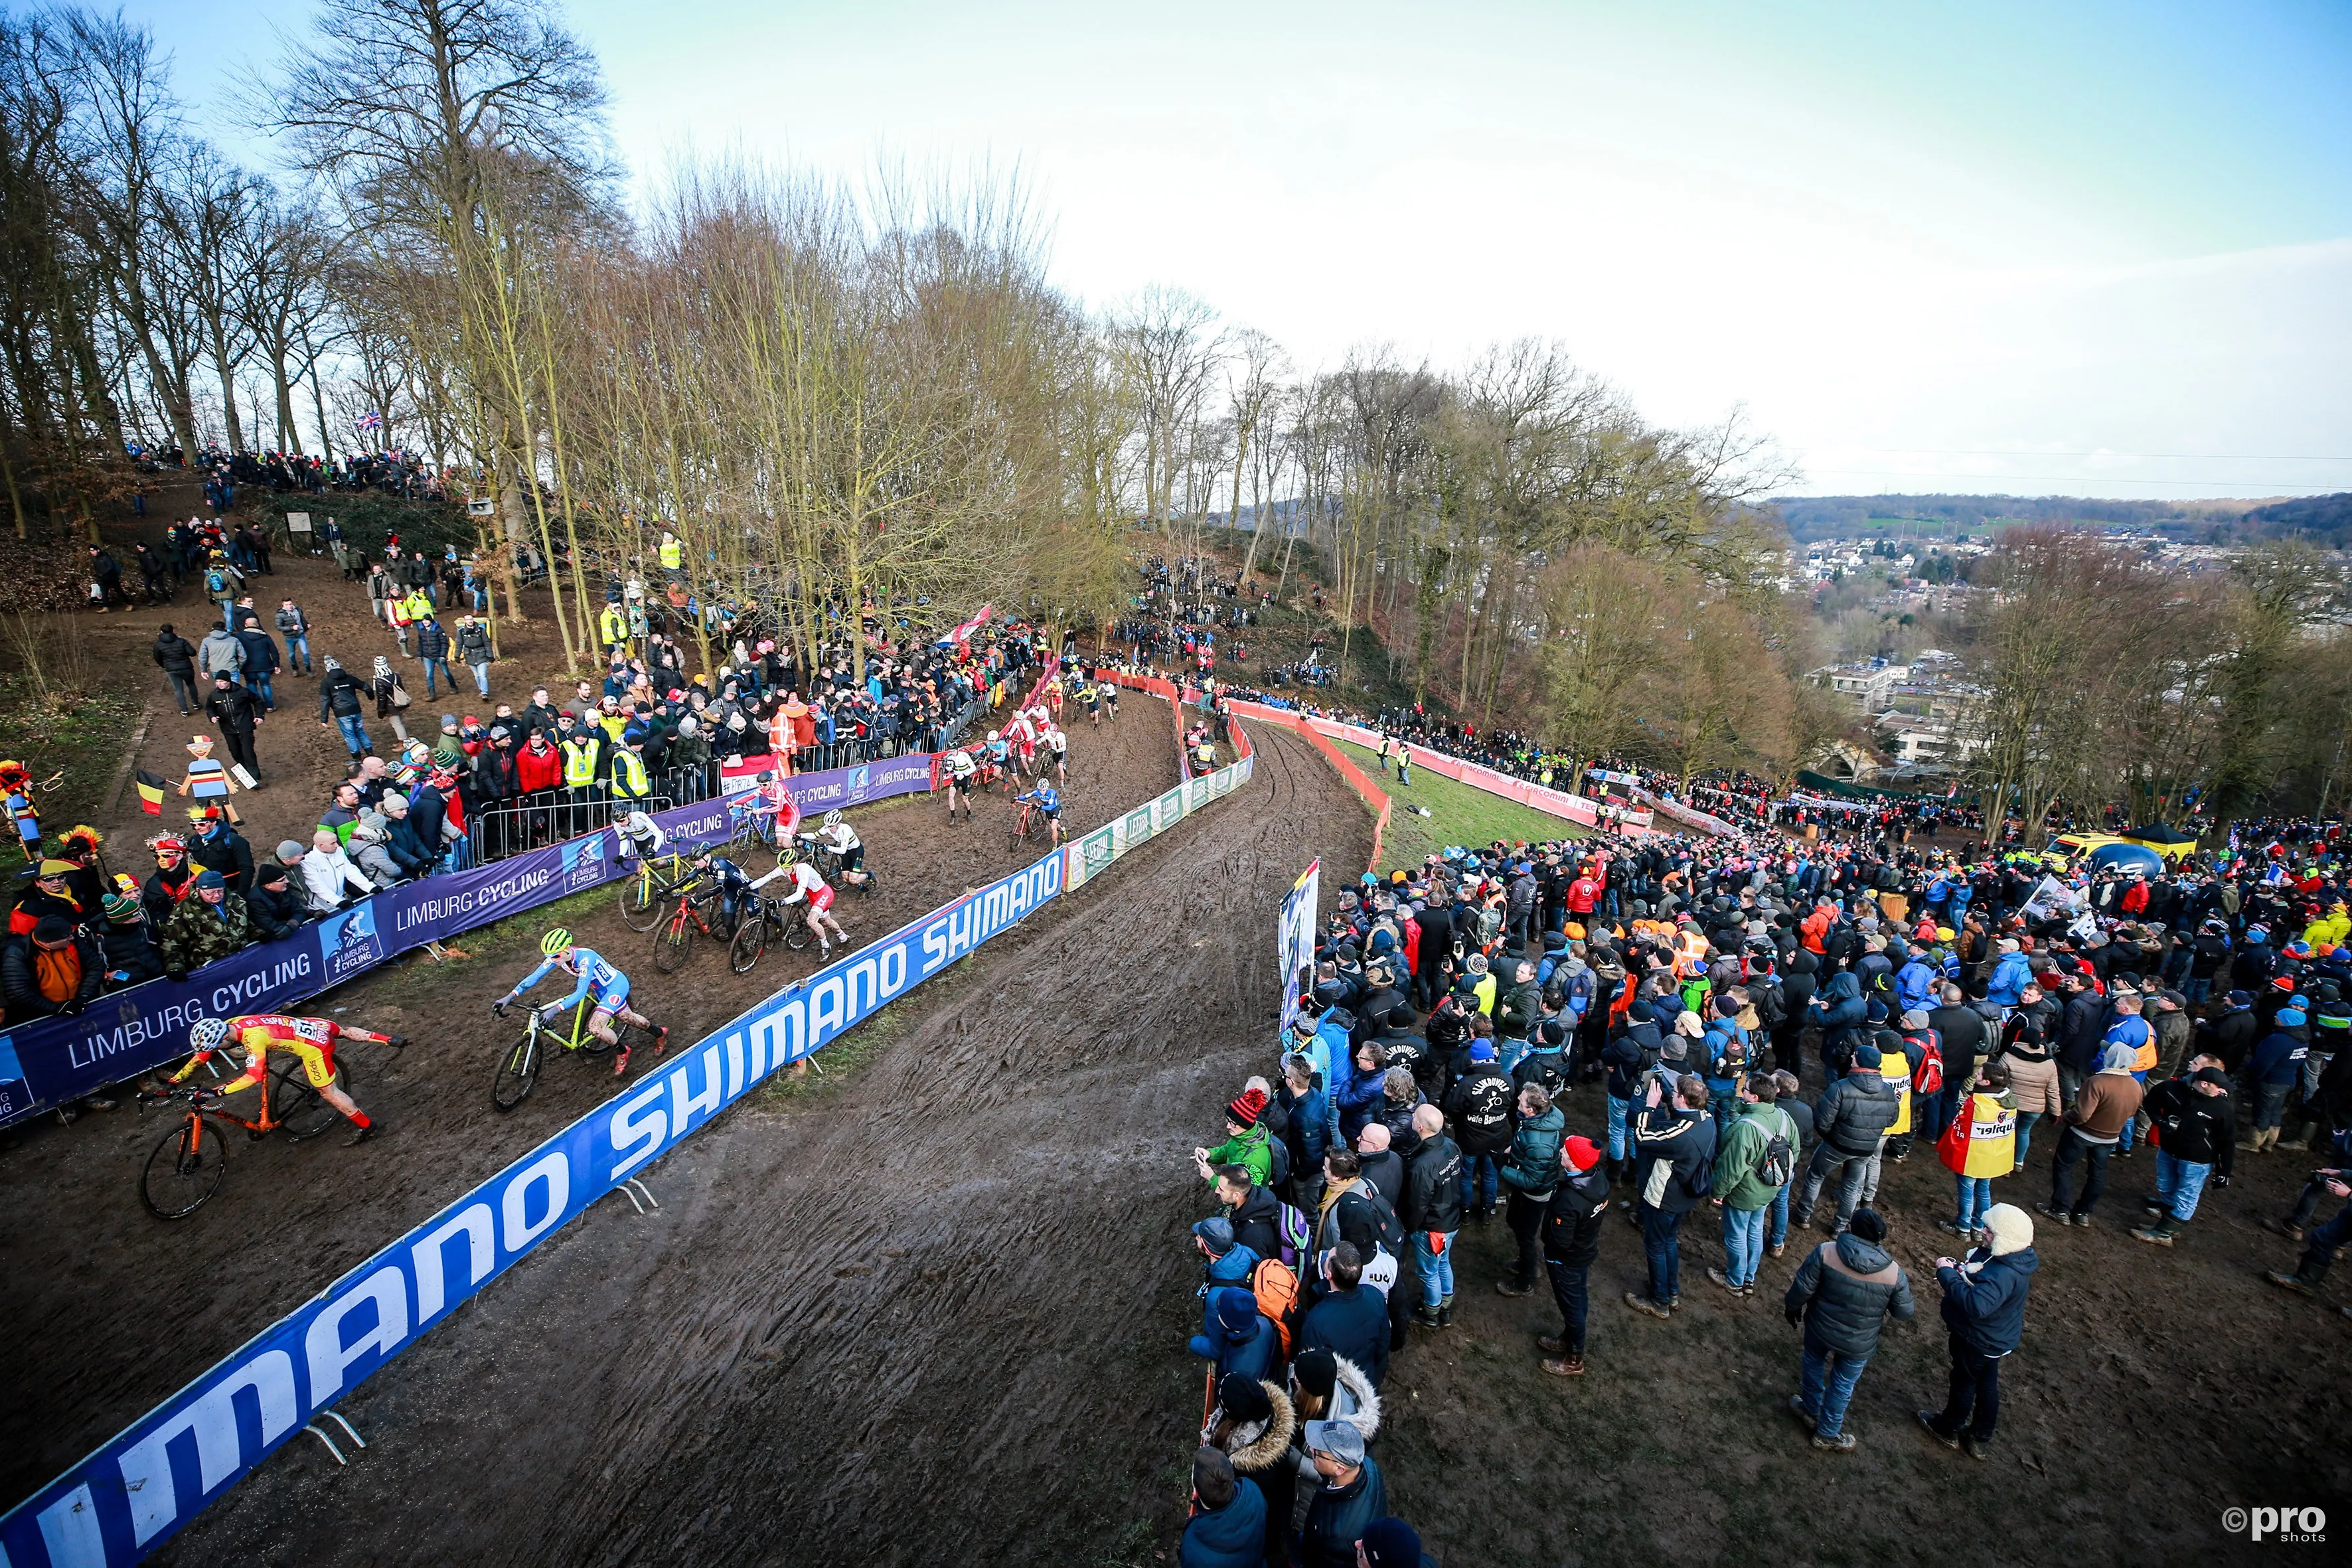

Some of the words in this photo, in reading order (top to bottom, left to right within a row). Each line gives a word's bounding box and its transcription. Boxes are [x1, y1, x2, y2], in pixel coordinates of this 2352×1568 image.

[876, 768, 903, 787] LIMBURG
[905, 767, 929, 780] CYCLING
[807, 783, 842, 803] CYCLING
[1525, 785, 1569, 805] GIACOMINI
[1810, 799, 1824, 807] UCI
[676, 814, 722, 839] CYCLING
[576, 865, 598, 878] LIMBURG
[576, 872, 598, 884] CYCLING
[397, 892, 473, 931] LIMBURG
[478, 868, 550, 907] CYCLING
[921, 854, 1061, 975] SHIMANO
[341, 943, 370, 963] LIMBURG
[342, 951, 372, 971] CYCLING
[597, 965, 611, 981] FORCE
[68, 998, 204, 1069] LIMBURG
[212, 952, 311, 1012] CYCLING
[301, 1022, 313, 1036] 51
[609, 941, 907, 1182] SHIMANO
[0, 1152, 570, 1568] IMANO
